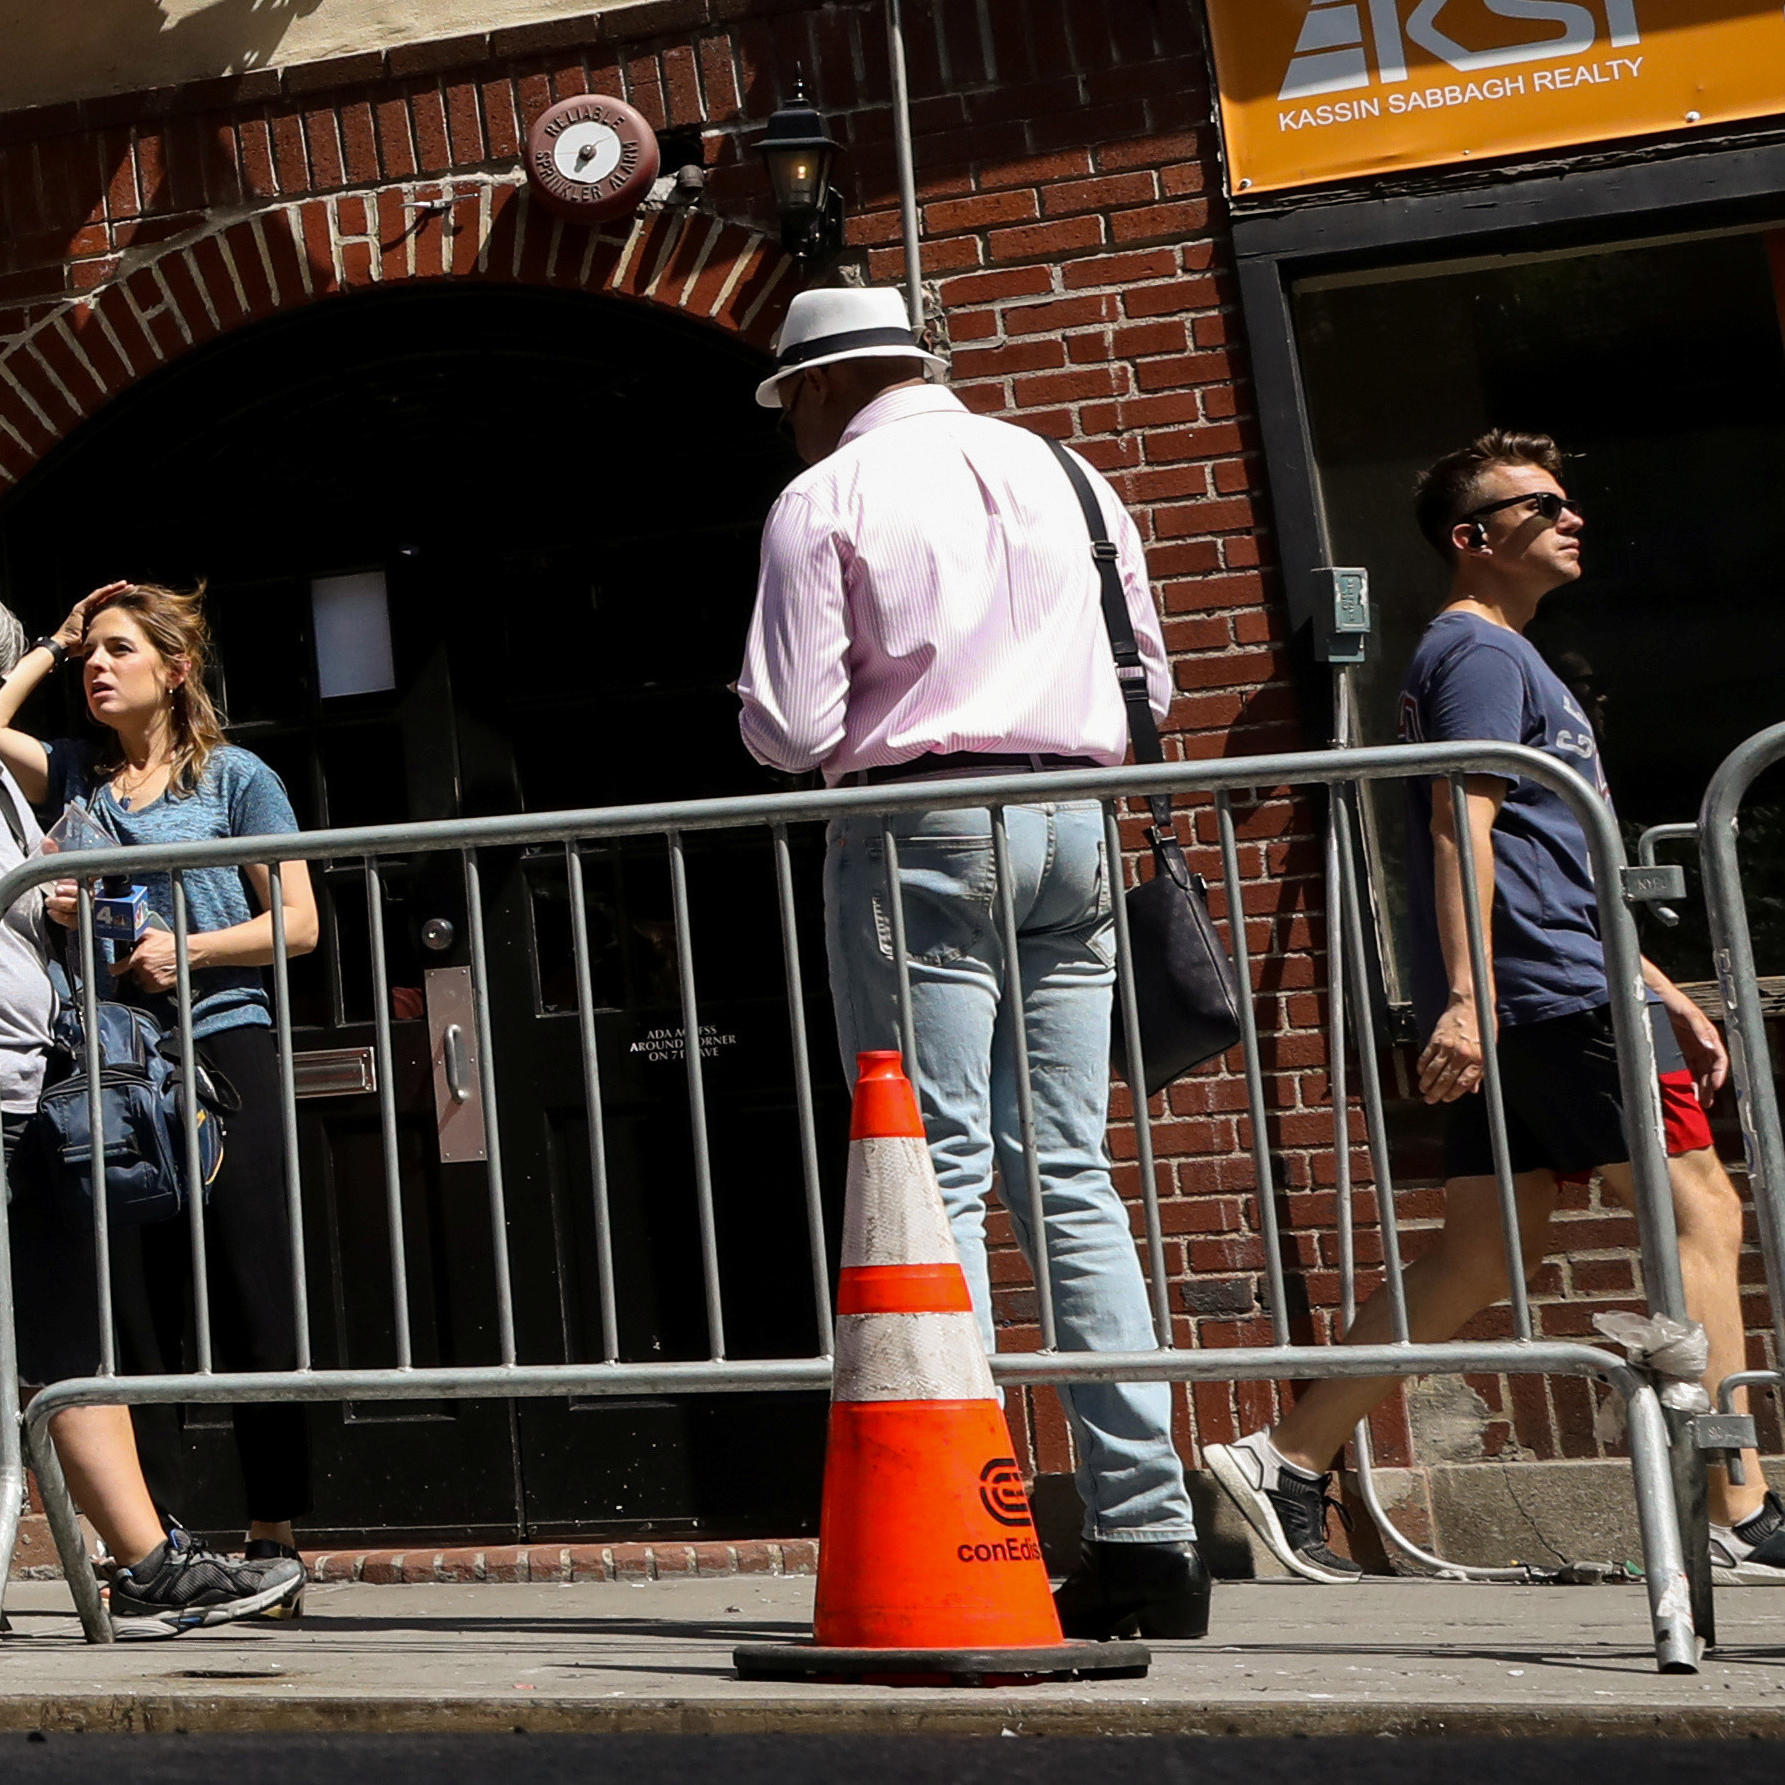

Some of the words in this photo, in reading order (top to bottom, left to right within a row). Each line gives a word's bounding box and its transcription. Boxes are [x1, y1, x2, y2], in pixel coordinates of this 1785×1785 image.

[1278, 98, 1380, 132] KASSIN
[1388, 75, 1525, 114] SABBAGH
[1533, 56, 1644, 93] REALTY
[544, 105, 626, 138] RELIABLE
[535, 149, 604, 203] SPRINKLER
[608, 140, 639, 192] ALARM
[96, 905, 113, 925] 4
[646, 1028, 673, 1040] ADA
[629, 1039, 684, 1053] AROUND
[648, 1050, 669, 1062] ON
